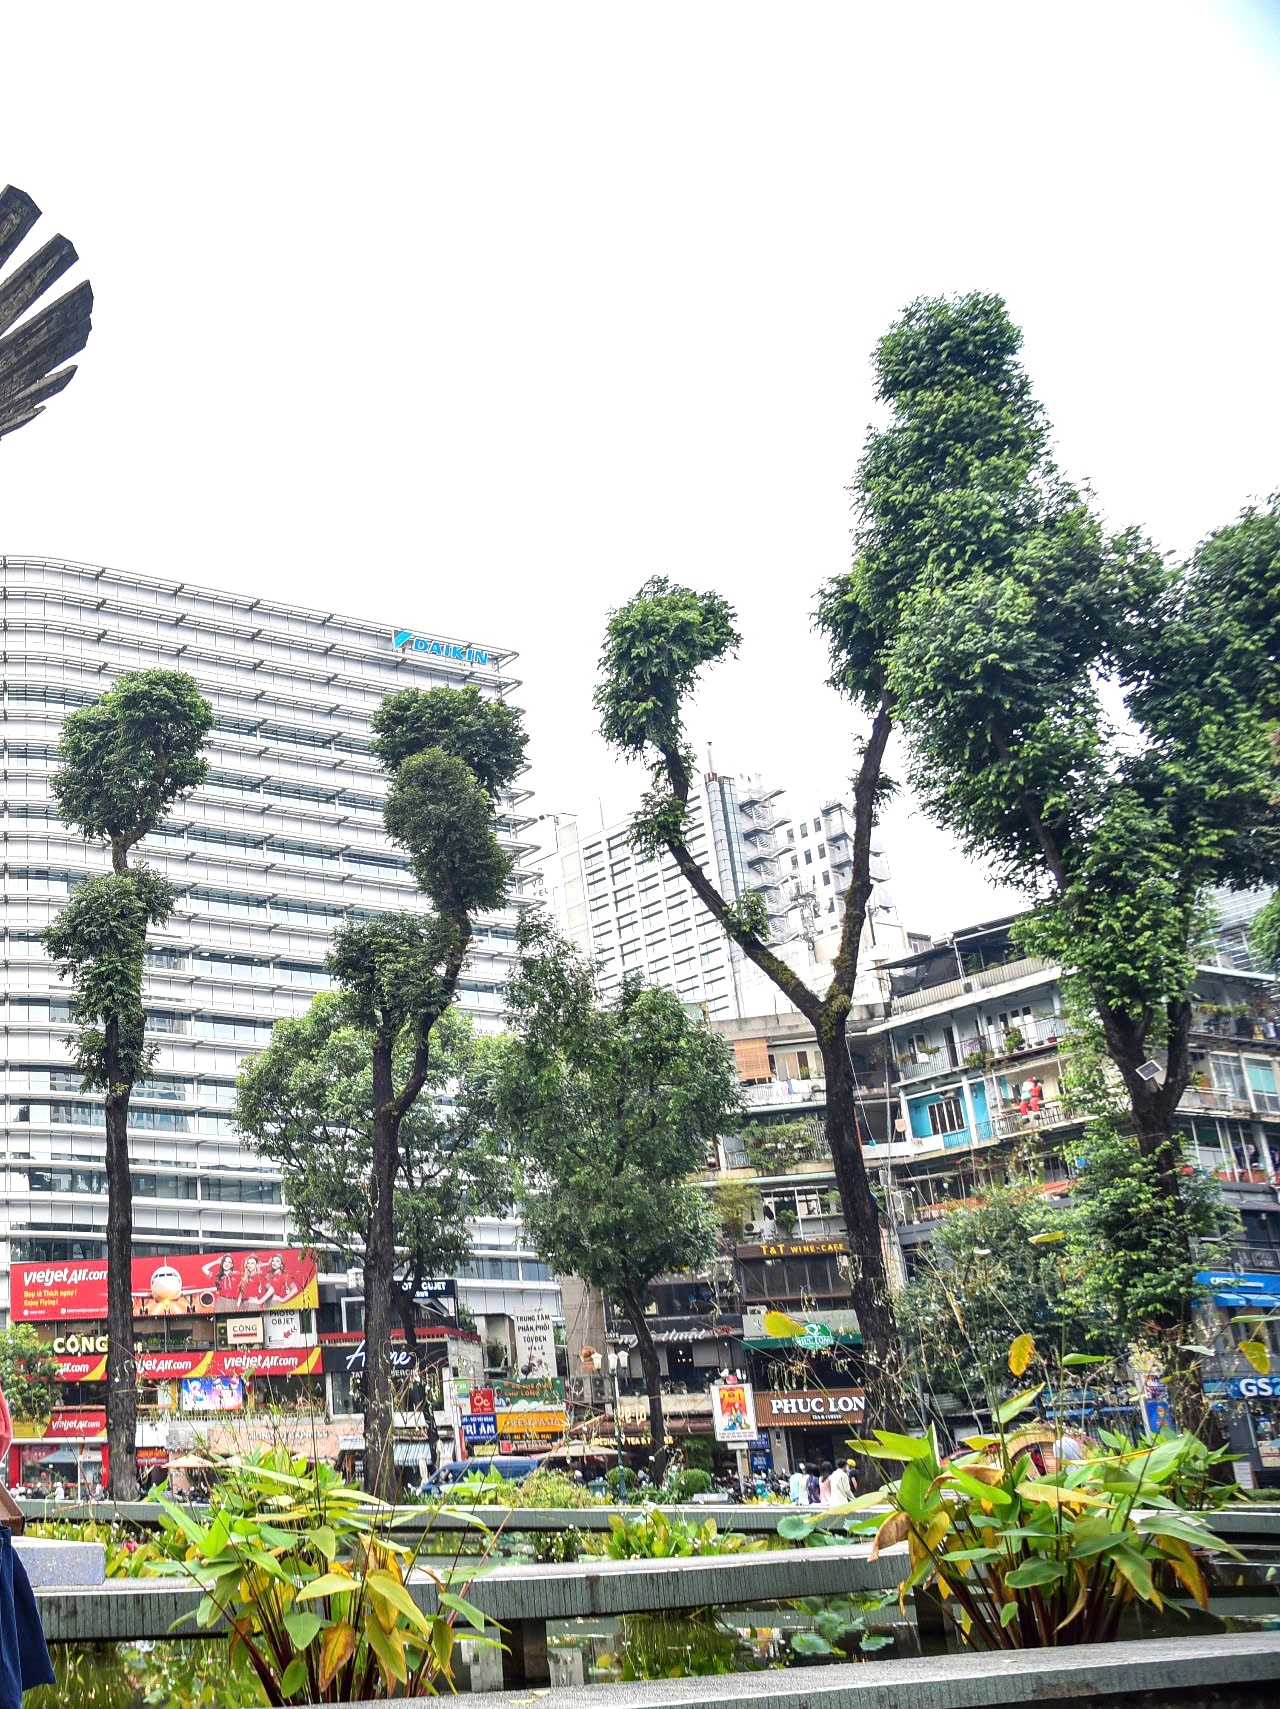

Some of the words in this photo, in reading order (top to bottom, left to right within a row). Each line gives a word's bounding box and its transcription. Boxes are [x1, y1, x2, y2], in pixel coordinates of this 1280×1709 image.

[413, 638, 488, 665] DAIKIN
[760, 1244, 785, 1255] T&T
[828, 1396, 866, 1413] LON
